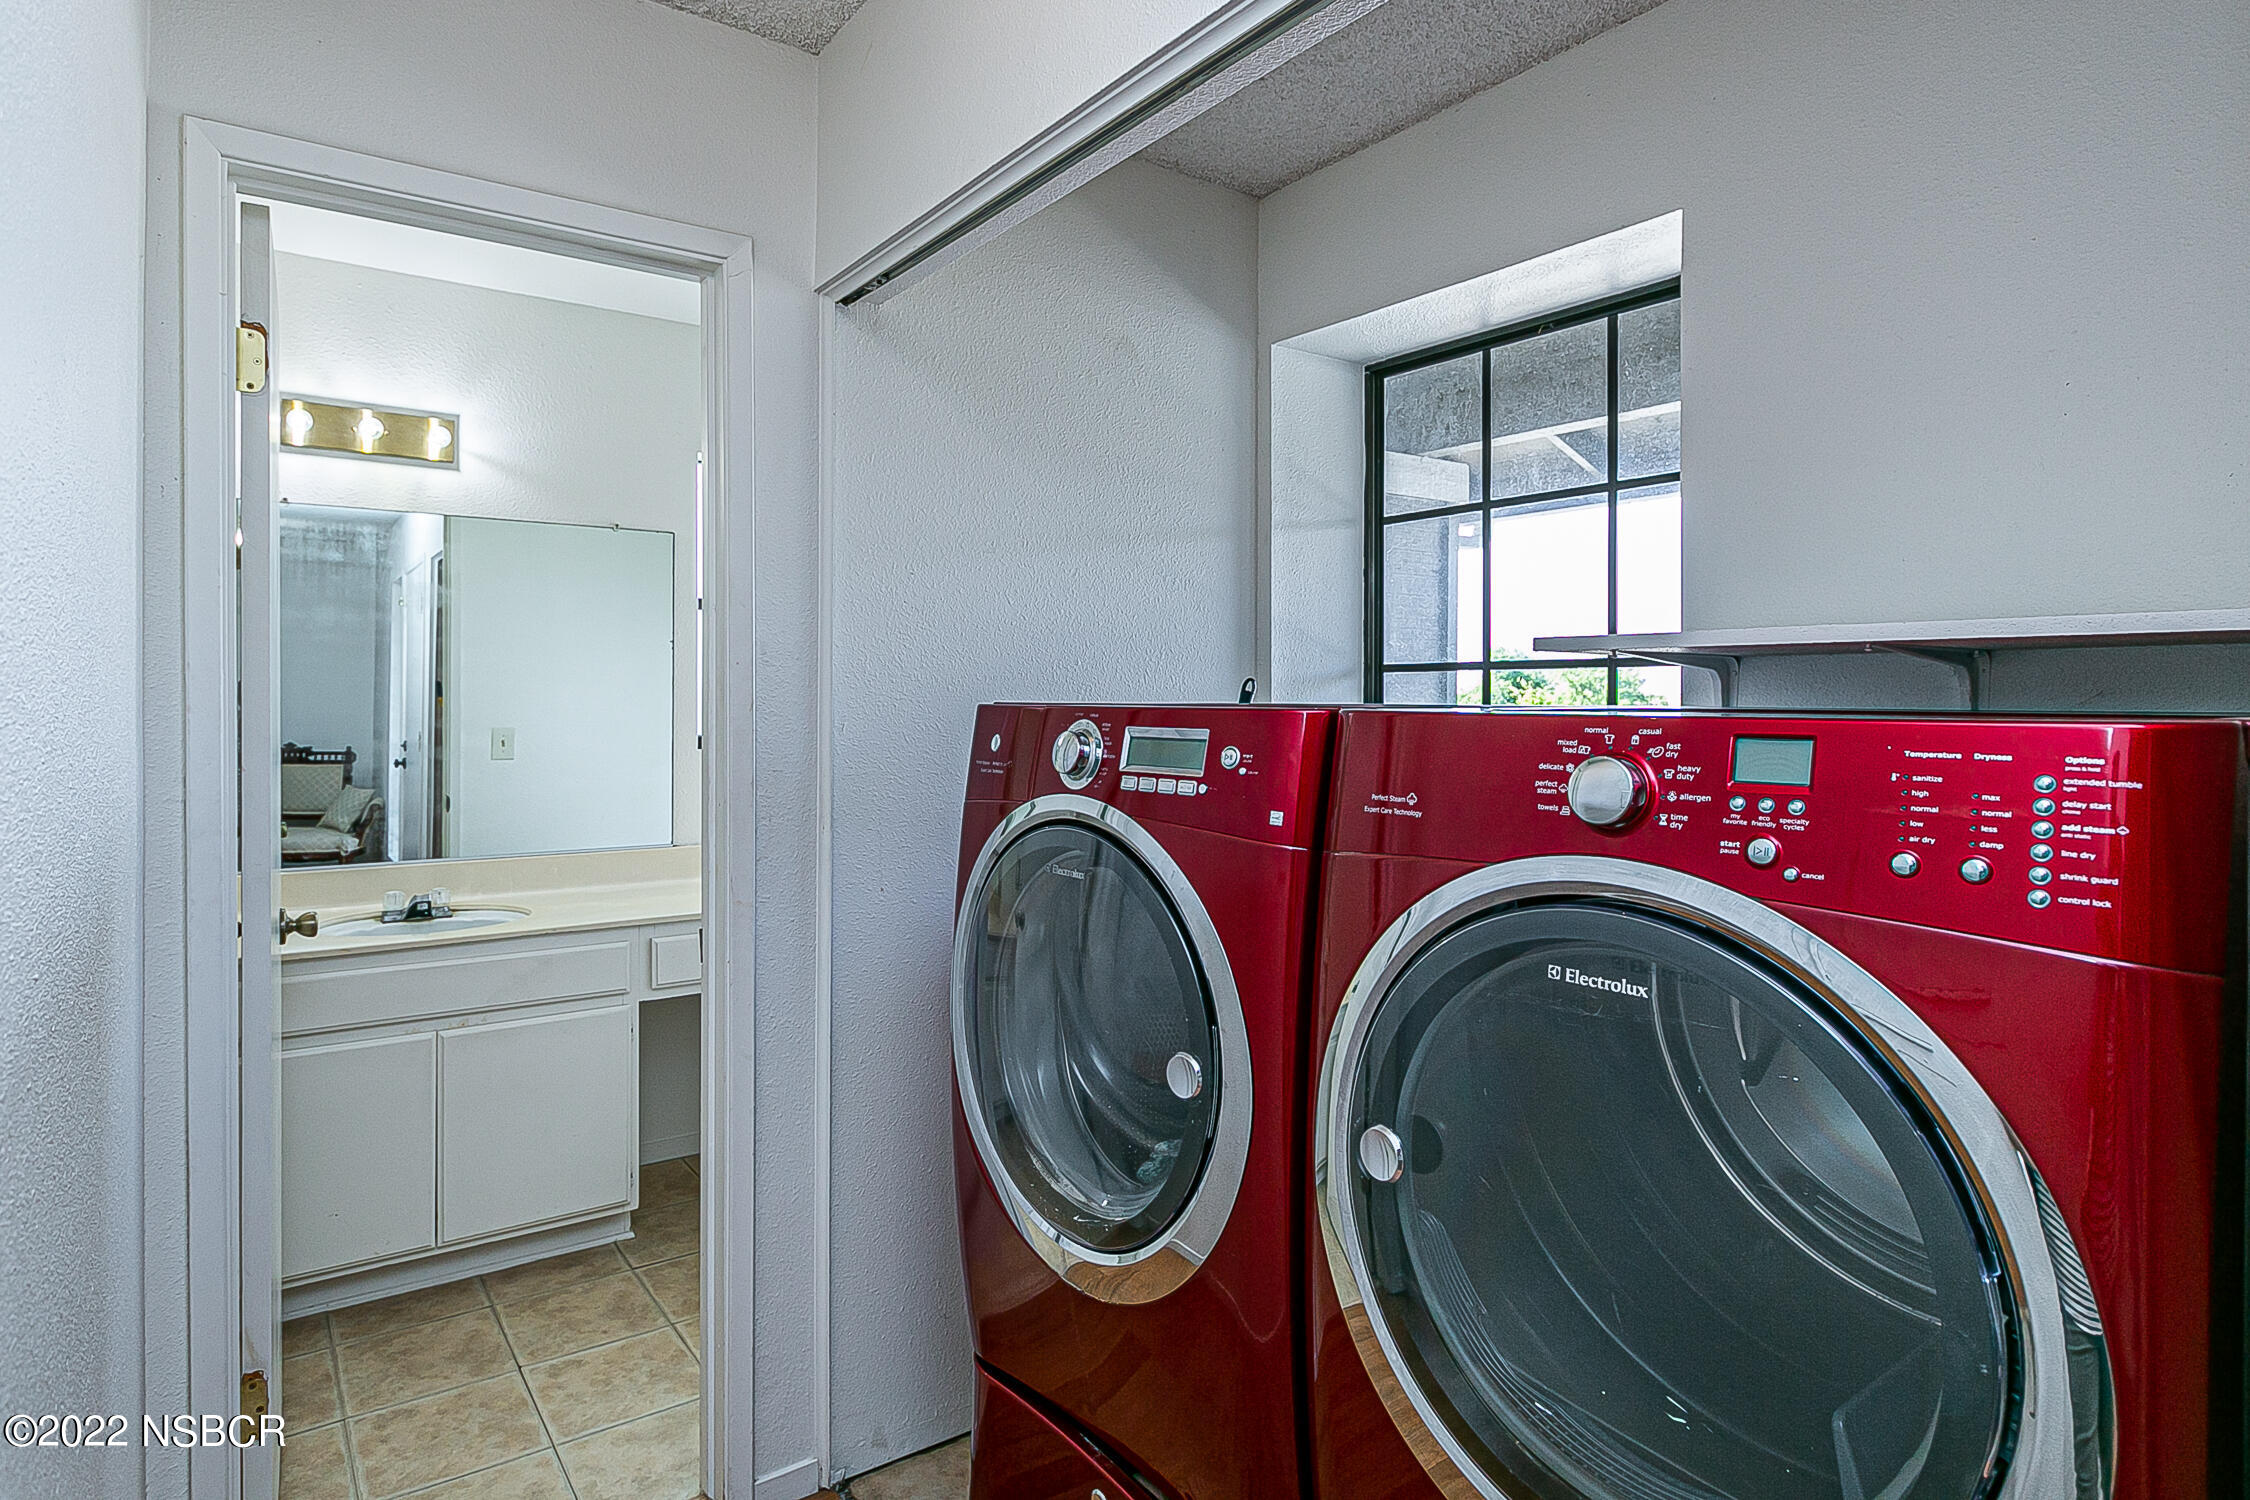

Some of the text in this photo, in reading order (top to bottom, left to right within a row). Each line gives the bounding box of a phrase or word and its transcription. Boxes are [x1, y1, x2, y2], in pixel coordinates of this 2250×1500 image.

[1584, 726, 1609, 735] normal
[1557, 738, 1578, 746] mixed
[1666, 742, 1681, 750] fast
[1562, 746, 1577, 754] load
[1665, 751, 1679, 759] dry
[1904, 750, 1962, 760] Temperature
[1973, 752, 2013, 762] Dryness
[2064, 756, 2105, 766] Options
[1538, 763, 1564, 771] delicate
[1677, 765, 1701, 774] heavy
[1676, 772, 1695, 782] duty
[1912, 774, 1943, 783] sanitize
[1535, 779, 1558, 789] perfect
[2063, 779, 2106, 788] extended
[1536, 787, 1557, 795] steam
[1911, 789, 1929, 798] high
[1371, 793, 1406, 803] Perfect Steam
[1679, 794, 1712, 803] allergen
[1981, 794, 2001, 802] max
[1364, 805, 1423, 818] Expert Care Technology
[1537, 803, 1559, 812] towels
[1910, 805, 1939, 814] normal
[1670, 813, 1689, 822] time
[1981, 809, 2012, 818] normal
[1669, 821, 1684, 830] dry
[1722, 817, 1748, 826] favorite
[1751, 820, 1777, 829] friendly
[1779, 817, 1810, 826] specialty
[1909, 820, 1924, 828] low
[1783, 824, 1805, 832] cycles
[1980, 825, 1998, 833] less
[1720, 840, 1740, 848] start
[1908, 835, 1935, 845] air dry
[1979, 840, 2004, 850] damp
[1720, 848, 1739, 856] pause
[2060, 850, 2096, 861] line dry
[1801, 872, 1825, 881] cancel
[2059, 872, 2119, 886] shrink guard
[2057, 895, 2112, 908] control lock
[1565, 967, 1649, 999] Electrolux
